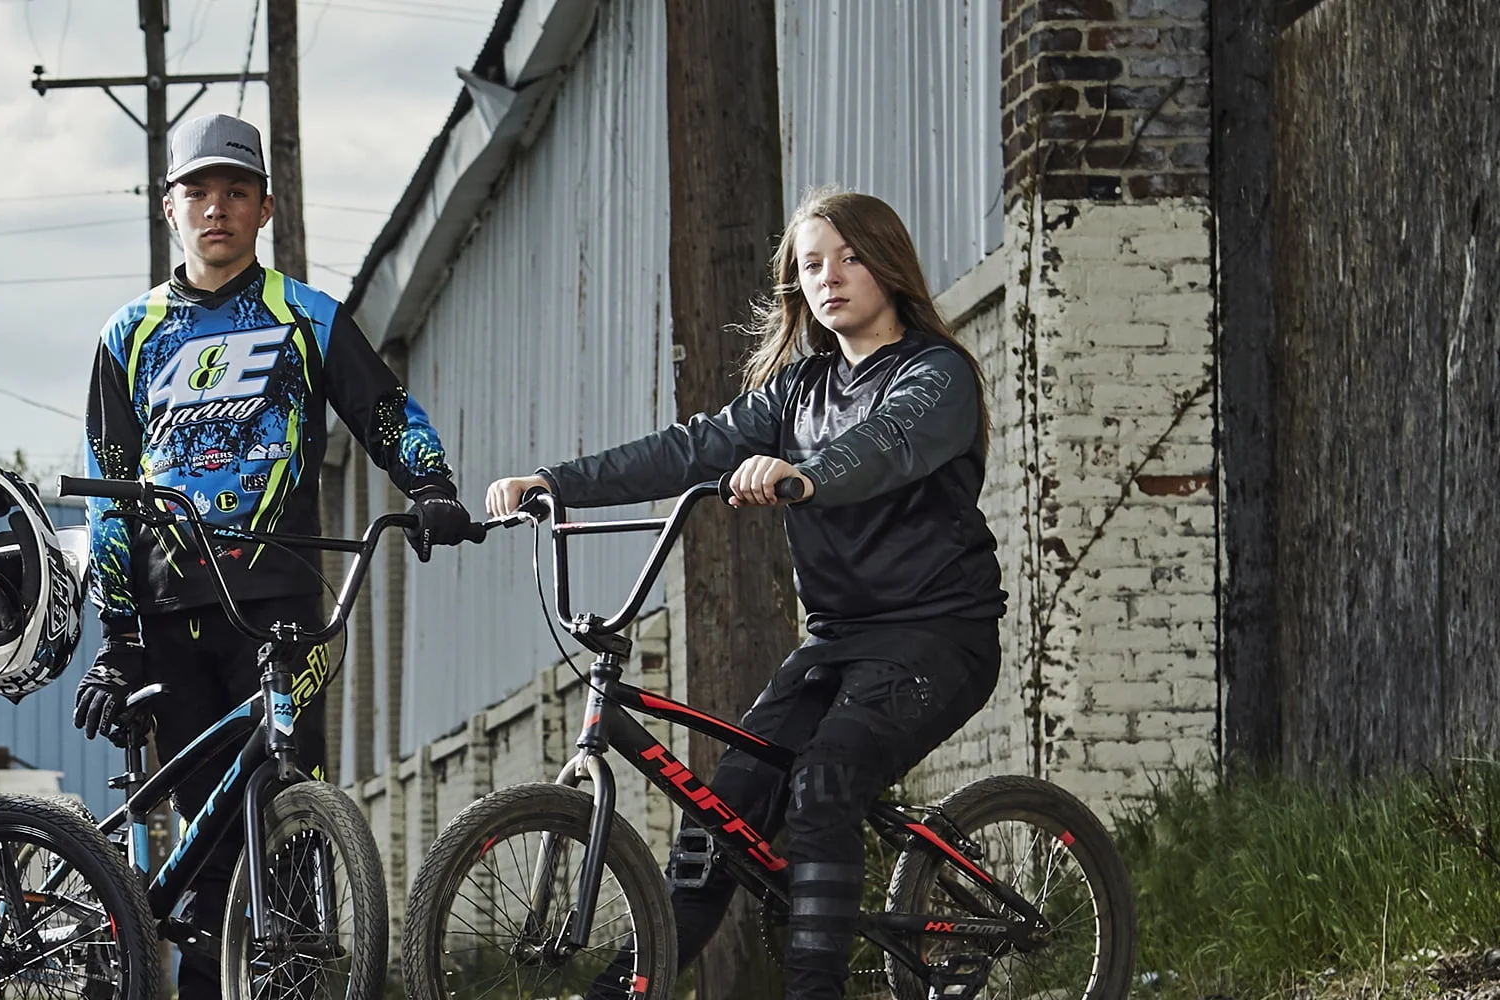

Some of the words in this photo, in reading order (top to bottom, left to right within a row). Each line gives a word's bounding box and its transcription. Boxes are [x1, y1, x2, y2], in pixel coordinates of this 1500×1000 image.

[148, 397, 268, 447] Racing
[192, 451, 233, 462] POWERS
[219, 493, 237, 510] E
[640, 743, 789, 871] HUFFY
